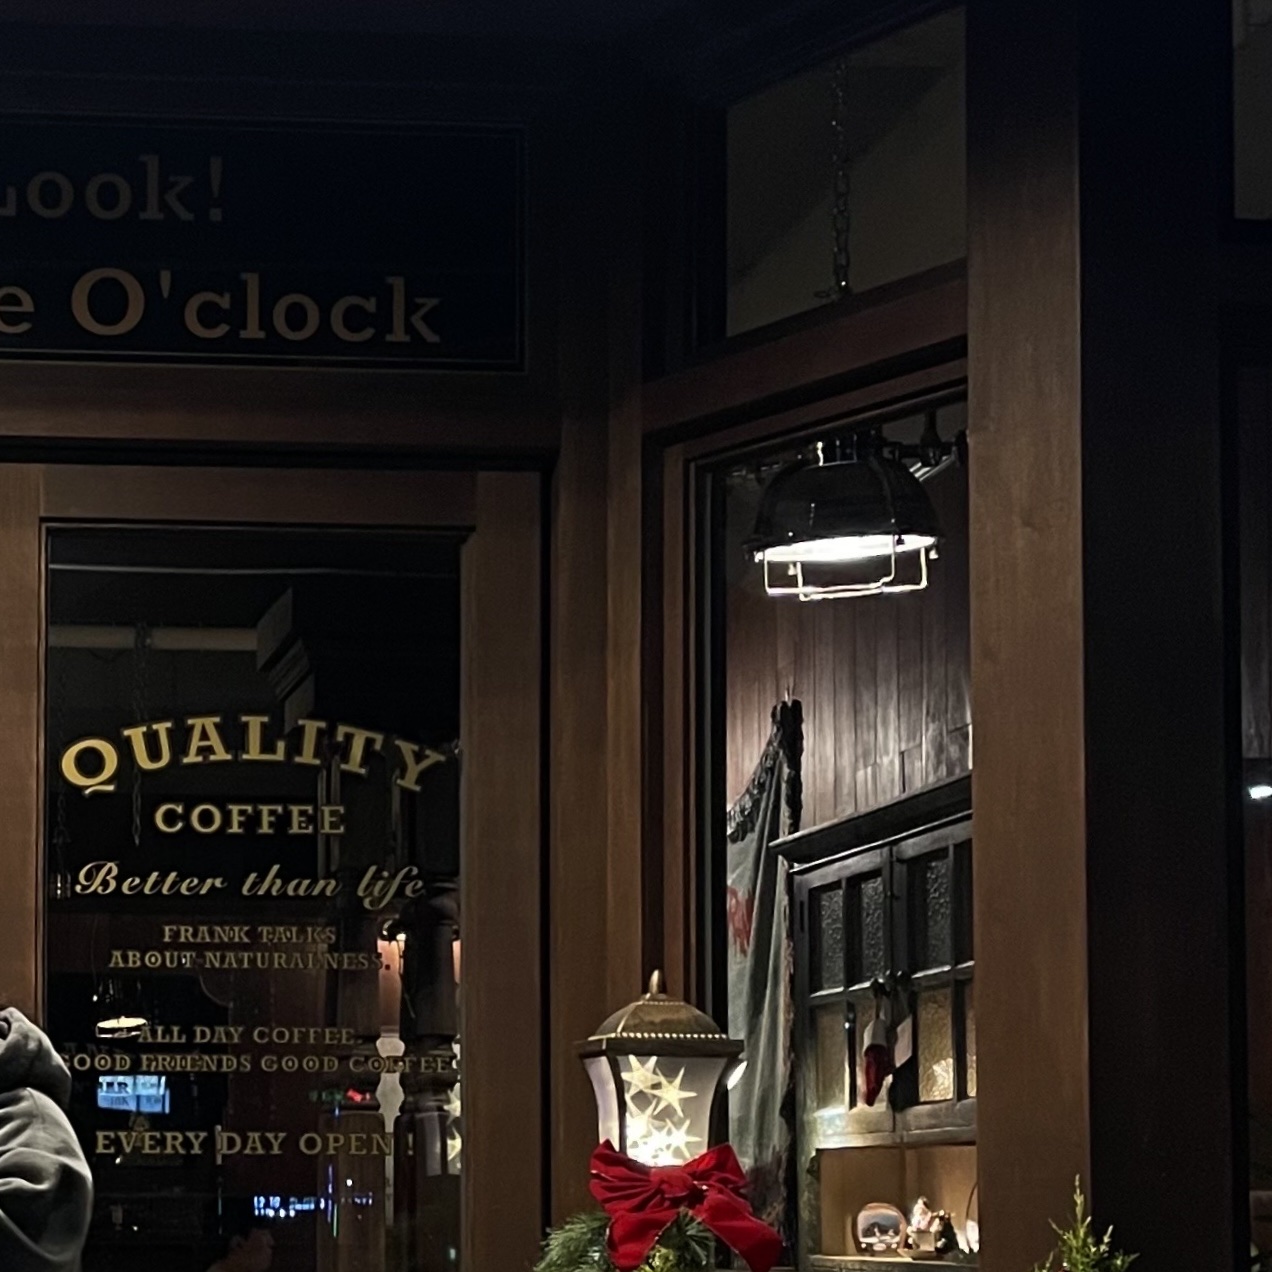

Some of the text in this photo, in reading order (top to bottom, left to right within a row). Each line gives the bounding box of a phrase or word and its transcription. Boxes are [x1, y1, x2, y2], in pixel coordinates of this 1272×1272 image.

[70, 265, 443, 345] O'clock
[61, 715, 446, 795] QUALITY
[154, 803, 346, 835] COFFEE
[74, 860, 427, 911] Better than life
[162, 924, 338, 945] FRANK TALKS
[108, 949, 197, 970] ABOUT
[137, 1025, 188, 1044] ALL
[193, 1026, 246, 1045] DAY
[139, 1053, 252, 1074] FRIENDS
[259, 1054, 339, 1073] GOOD
[94, 1130, 208, 1156] EVERY
[219, 1131, 287, 1156] DAY
